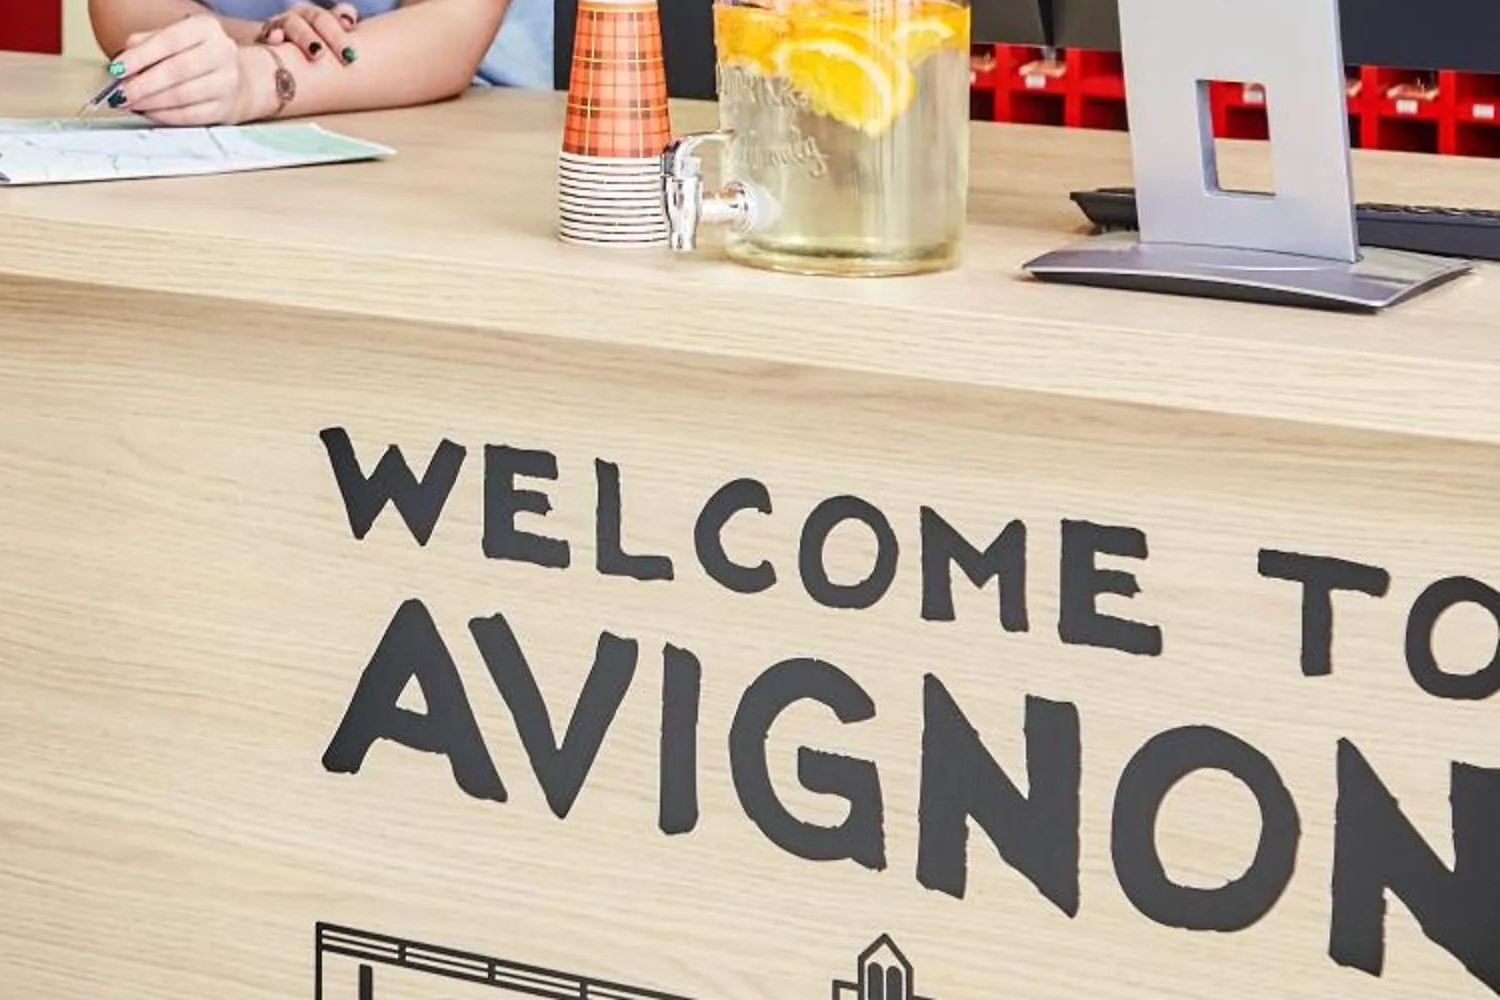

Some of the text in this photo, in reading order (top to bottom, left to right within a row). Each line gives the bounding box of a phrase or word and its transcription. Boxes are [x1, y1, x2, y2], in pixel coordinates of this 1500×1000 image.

[319, 426, 1500, 701] WELCOME TO
[321, 598, 1500, 998] AVIGNON
